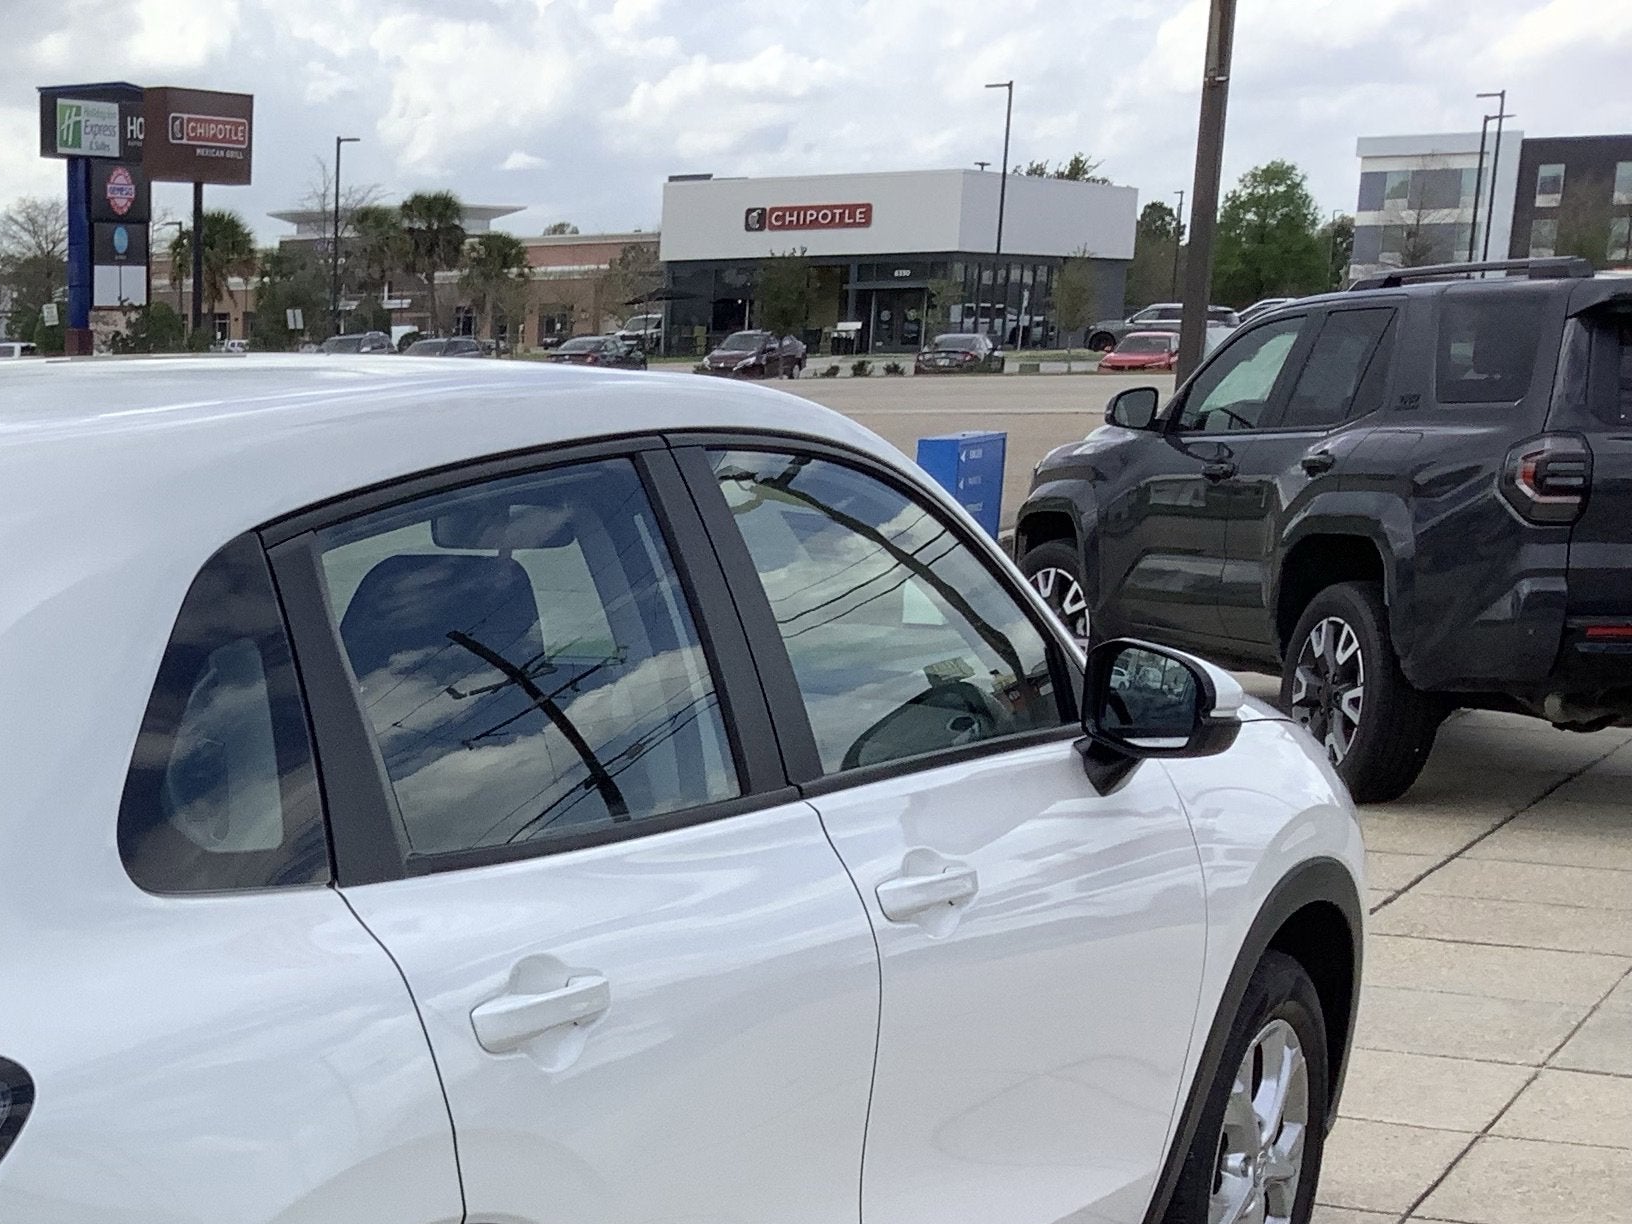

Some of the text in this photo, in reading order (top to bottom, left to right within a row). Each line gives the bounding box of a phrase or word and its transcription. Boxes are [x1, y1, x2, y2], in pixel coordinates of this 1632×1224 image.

[84, 119, 117, 139] Express
[188, 121, 245, 141] CHIPOTLE
[196, 148, 244, 160] MEXICAN GRILL
[771, 207, 867, 227] CHIPOTLE
